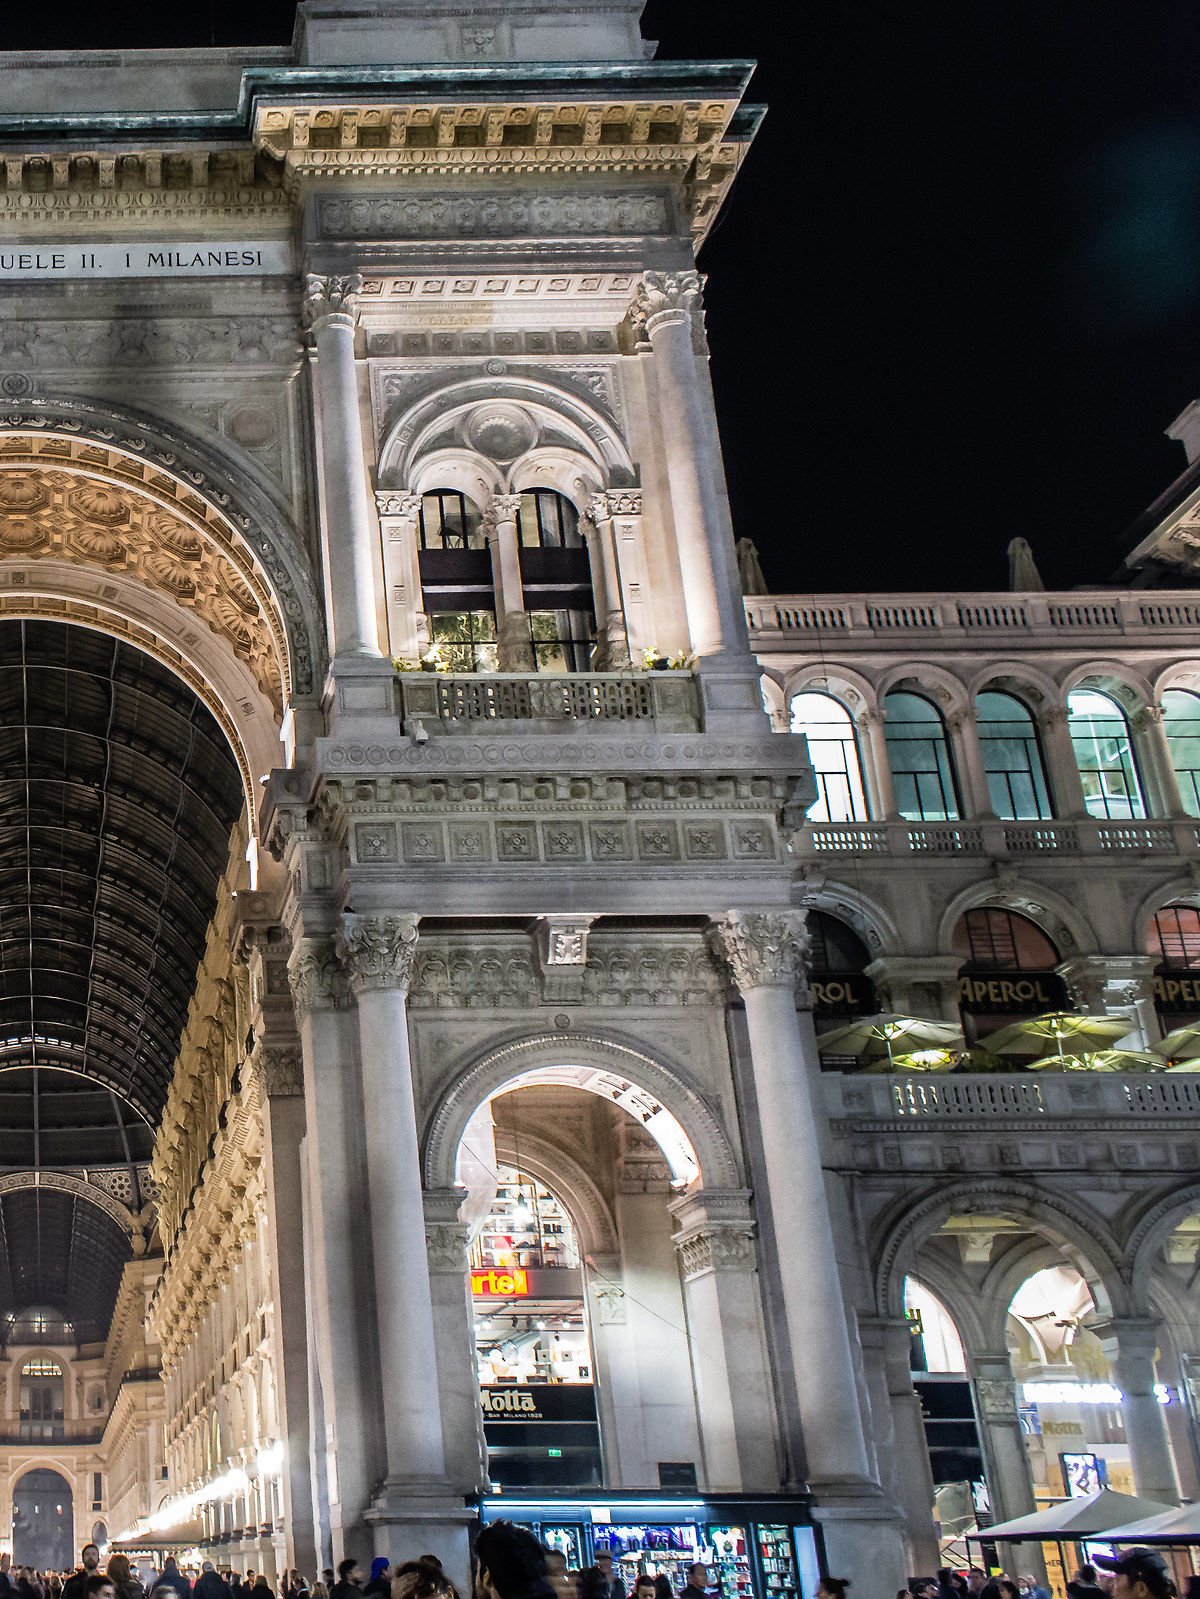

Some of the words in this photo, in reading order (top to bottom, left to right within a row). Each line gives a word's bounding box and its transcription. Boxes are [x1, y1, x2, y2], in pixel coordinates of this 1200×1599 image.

[125, 253, 131, 268] I
[147, 250, 262, 268] MILANESI
[960, 976, 1050, 1004] APEROL
